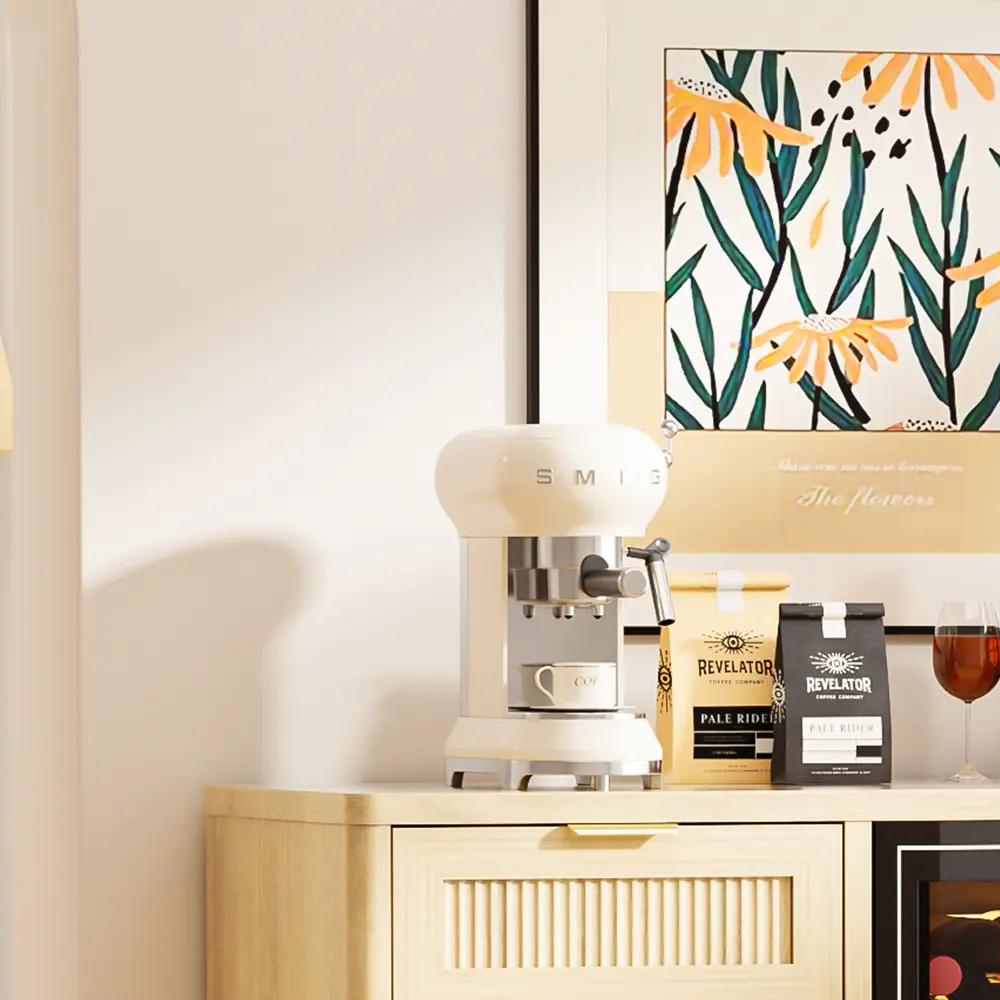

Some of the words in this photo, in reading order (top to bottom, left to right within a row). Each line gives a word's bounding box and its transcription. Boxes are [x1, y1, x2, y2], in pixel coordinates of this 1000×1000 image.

[797, 484, 843, 506] The
[844, 485, 935, 516] flowers
[698, 659, 774, 677] REVELATOR
[805, 677, 872, 693] REVELATOR
[701, 713, 732, 724] PALE
[810, 723, 836, 732] PALE
[840, 723, 874, 733] RIDER
